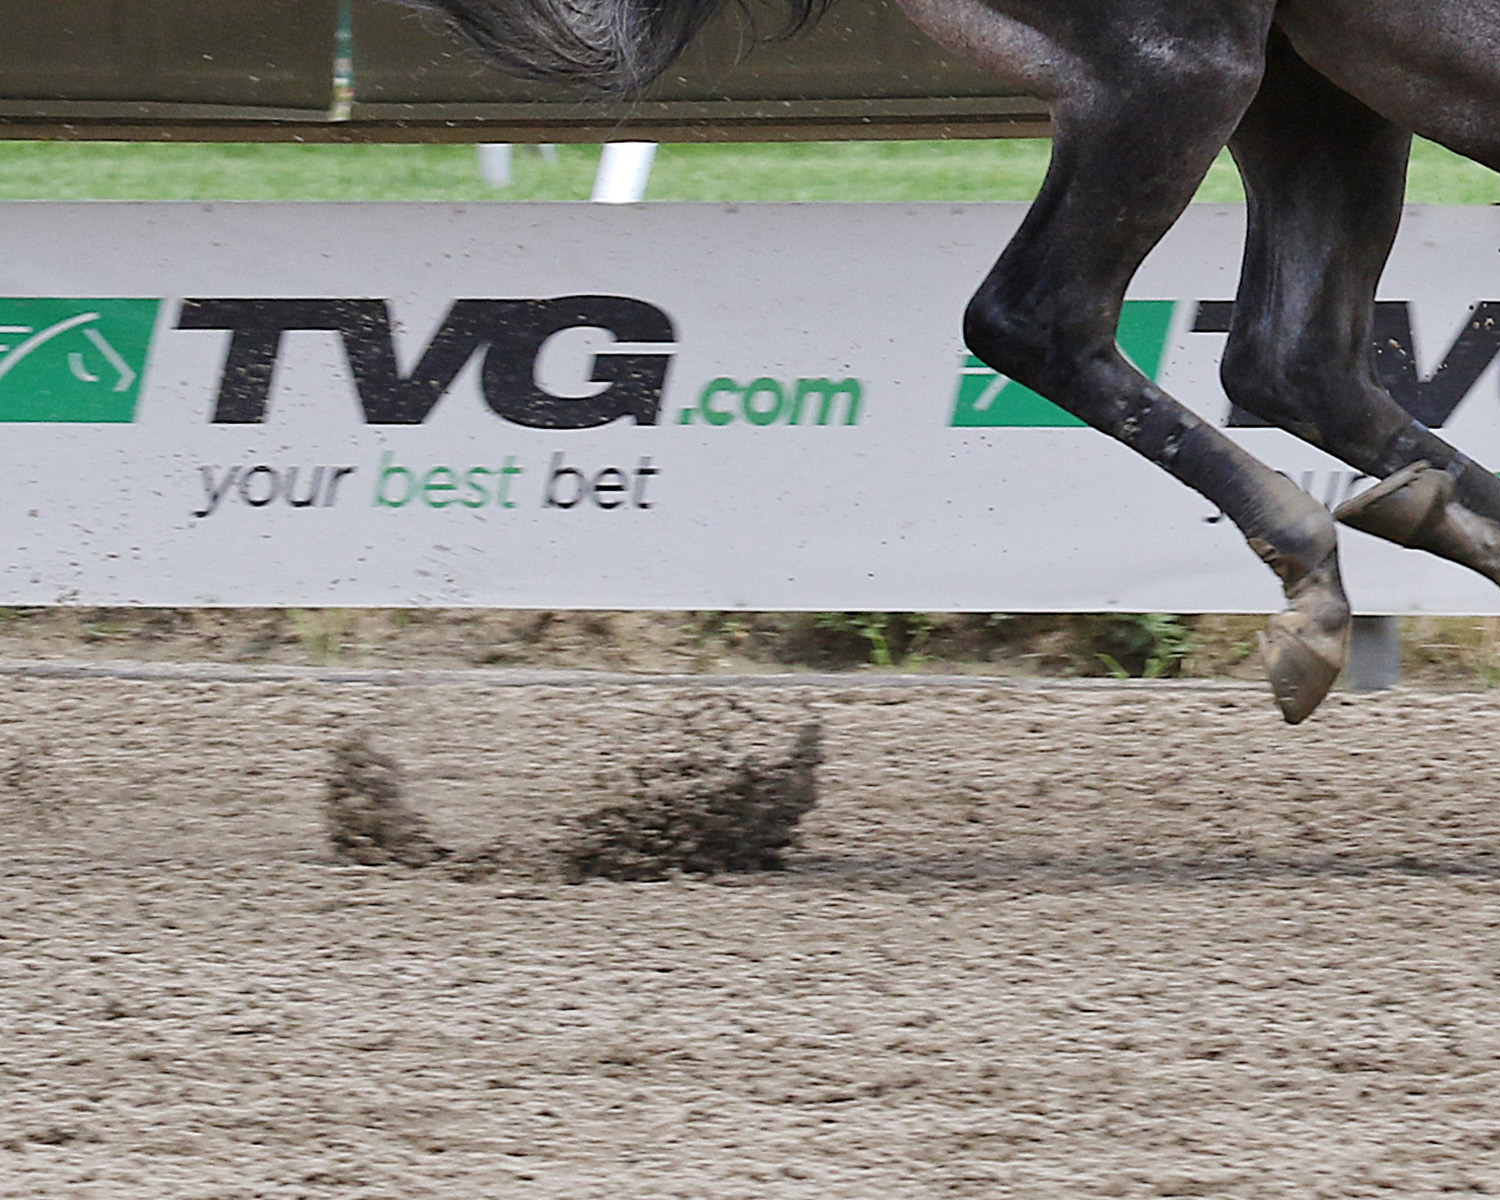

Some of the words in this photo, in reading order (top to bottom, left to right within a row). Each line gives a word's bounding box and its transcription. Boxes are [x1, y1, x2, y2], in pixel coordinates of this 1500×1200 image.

[193, 462, 358, 518] your
[372, 451, 525, 510] best
[540, 451, 663, 511] bet
